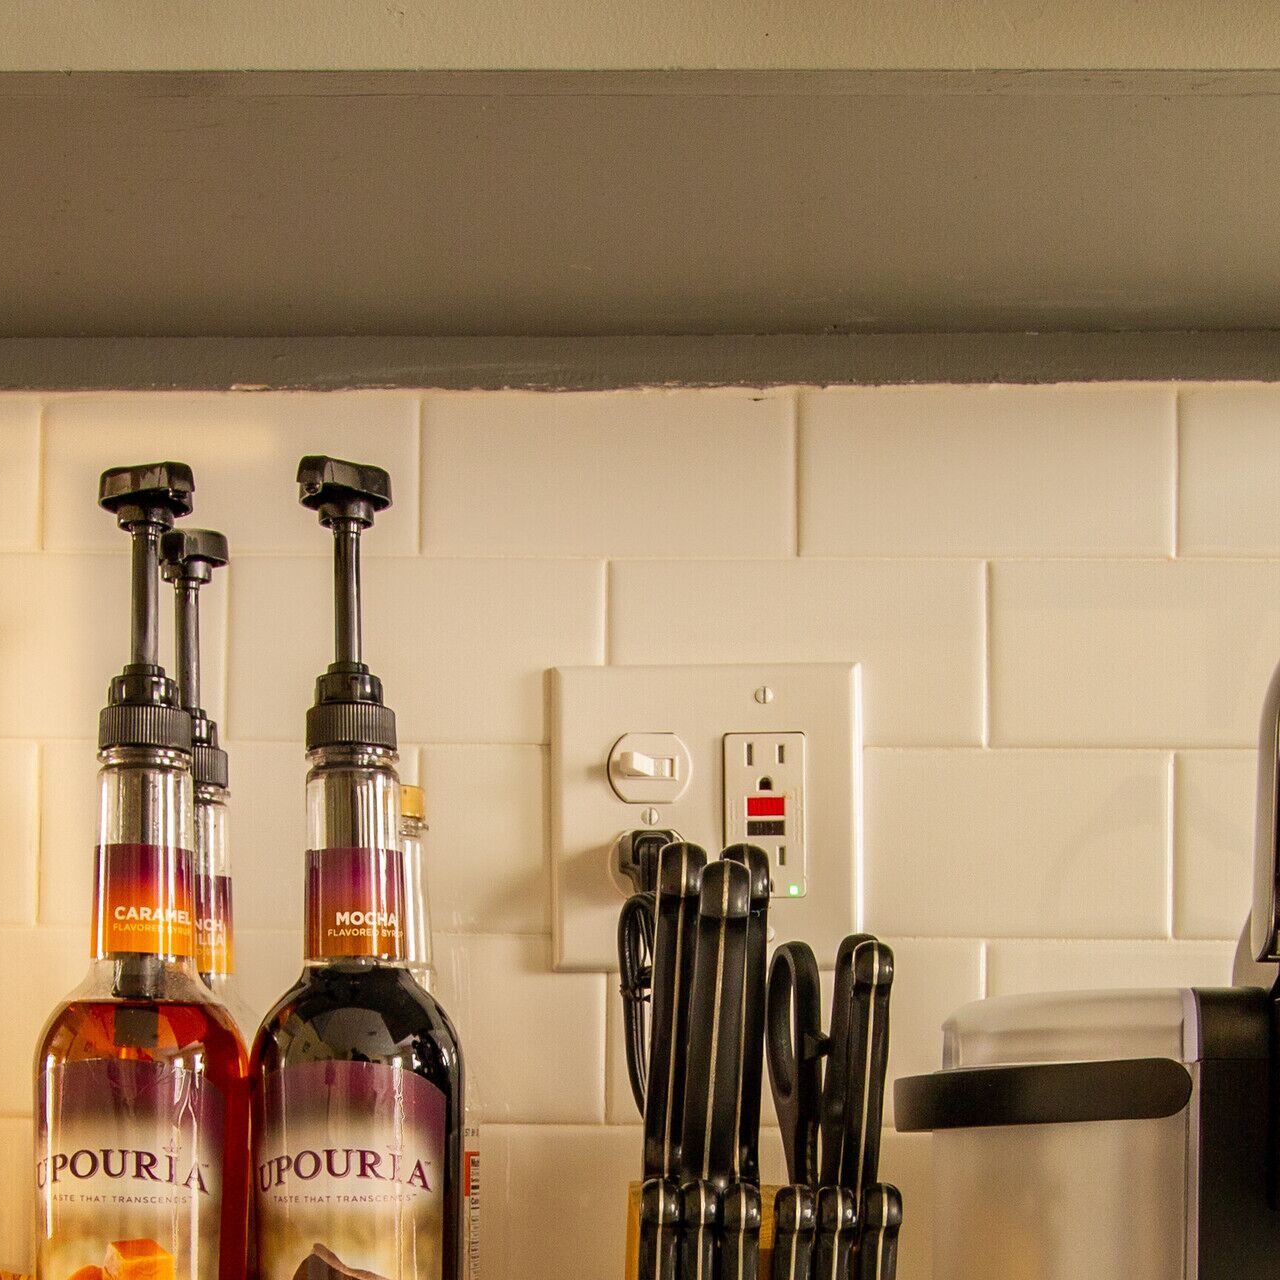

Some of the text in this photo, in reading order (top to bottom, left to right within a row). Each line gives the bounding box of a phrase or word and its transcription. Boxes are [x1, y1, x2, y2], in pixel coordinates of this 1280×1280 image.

[114, 906, 192, 925] CARAMEL
[336, 911, 398, 927] MOCHA
[113, 923, 164, 932] FLAVORED
[328, 928, 379, 937] FLAVORED
[53, 1194, 74, 1202] ASTE
[80, 1195, 107, 1203] THAT
[273, 1194, 301, 1203] TASTE
[303, 1195, 331, 1203] THAT
